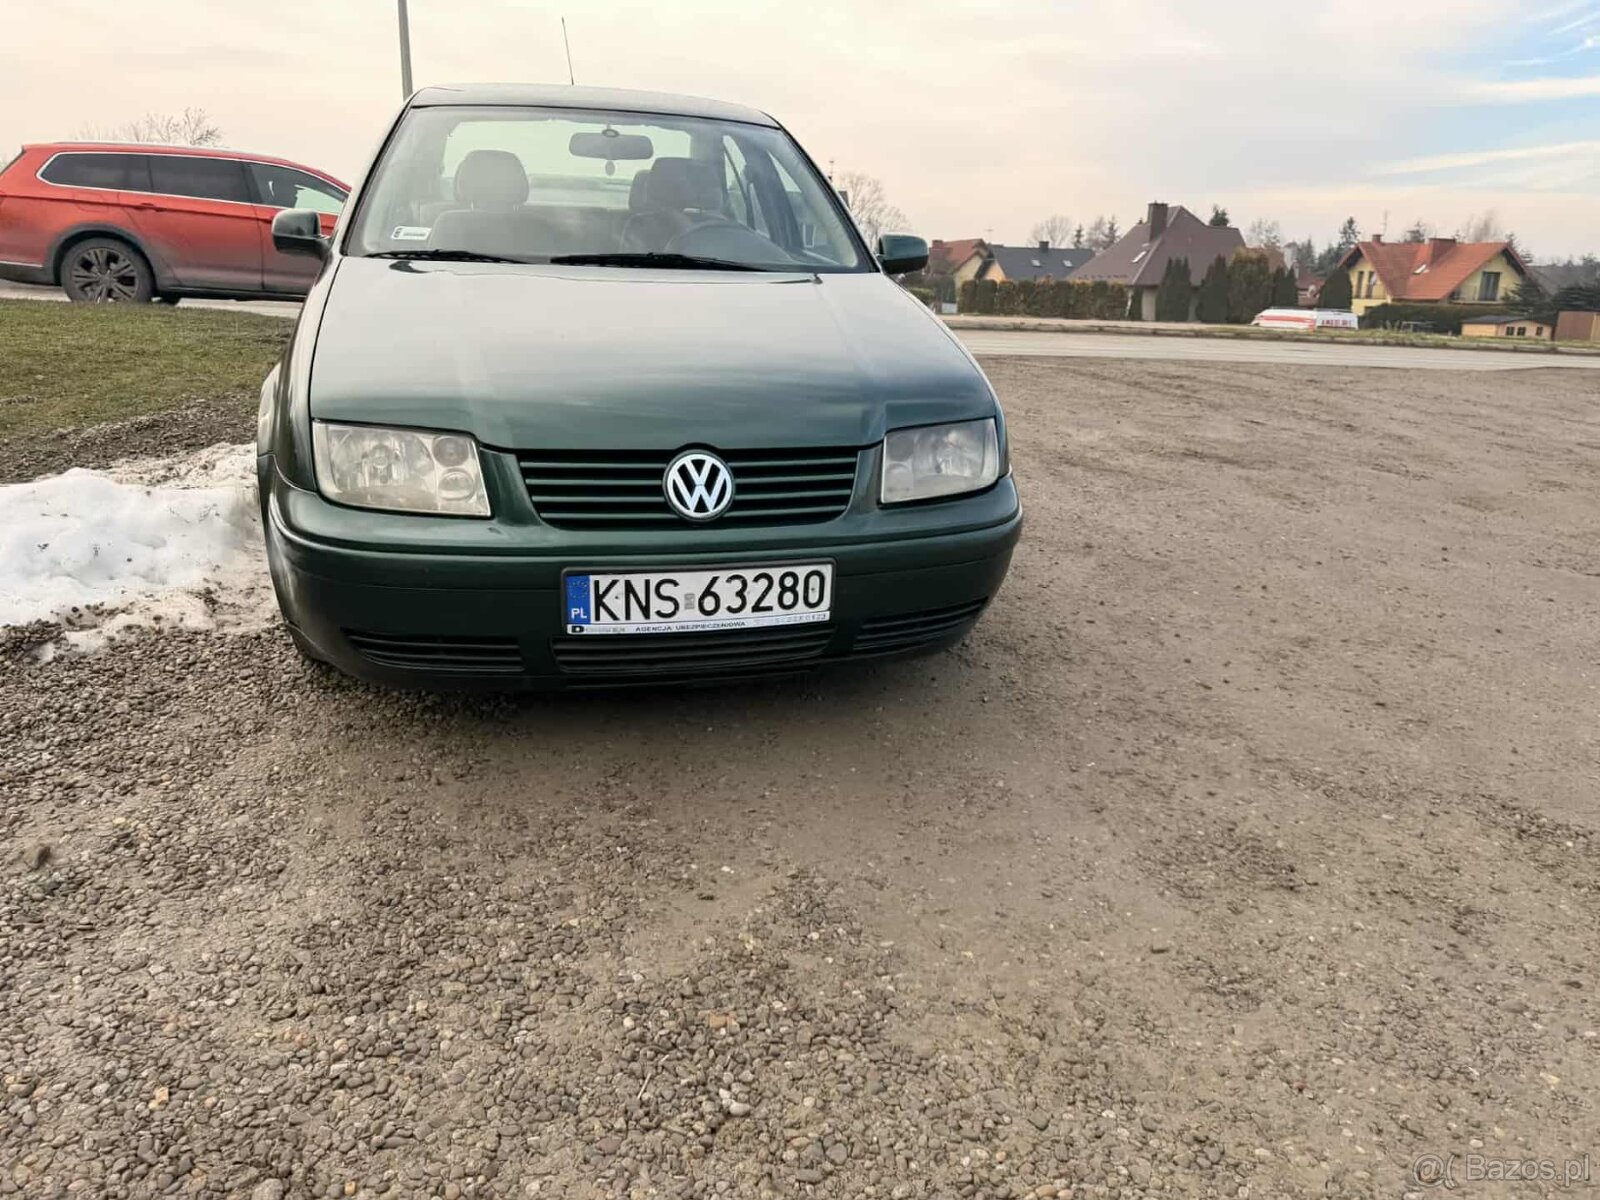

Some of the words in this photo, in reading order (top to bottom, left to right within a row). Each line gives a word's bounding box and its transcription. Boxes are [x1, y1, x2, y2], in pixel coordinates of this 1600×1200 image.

[666, 453, 733, 519] VW
[571, 608, 588, 619] PL
[593, 578, 680, 622] KNS
[698, 569, 826, 617] 63280
